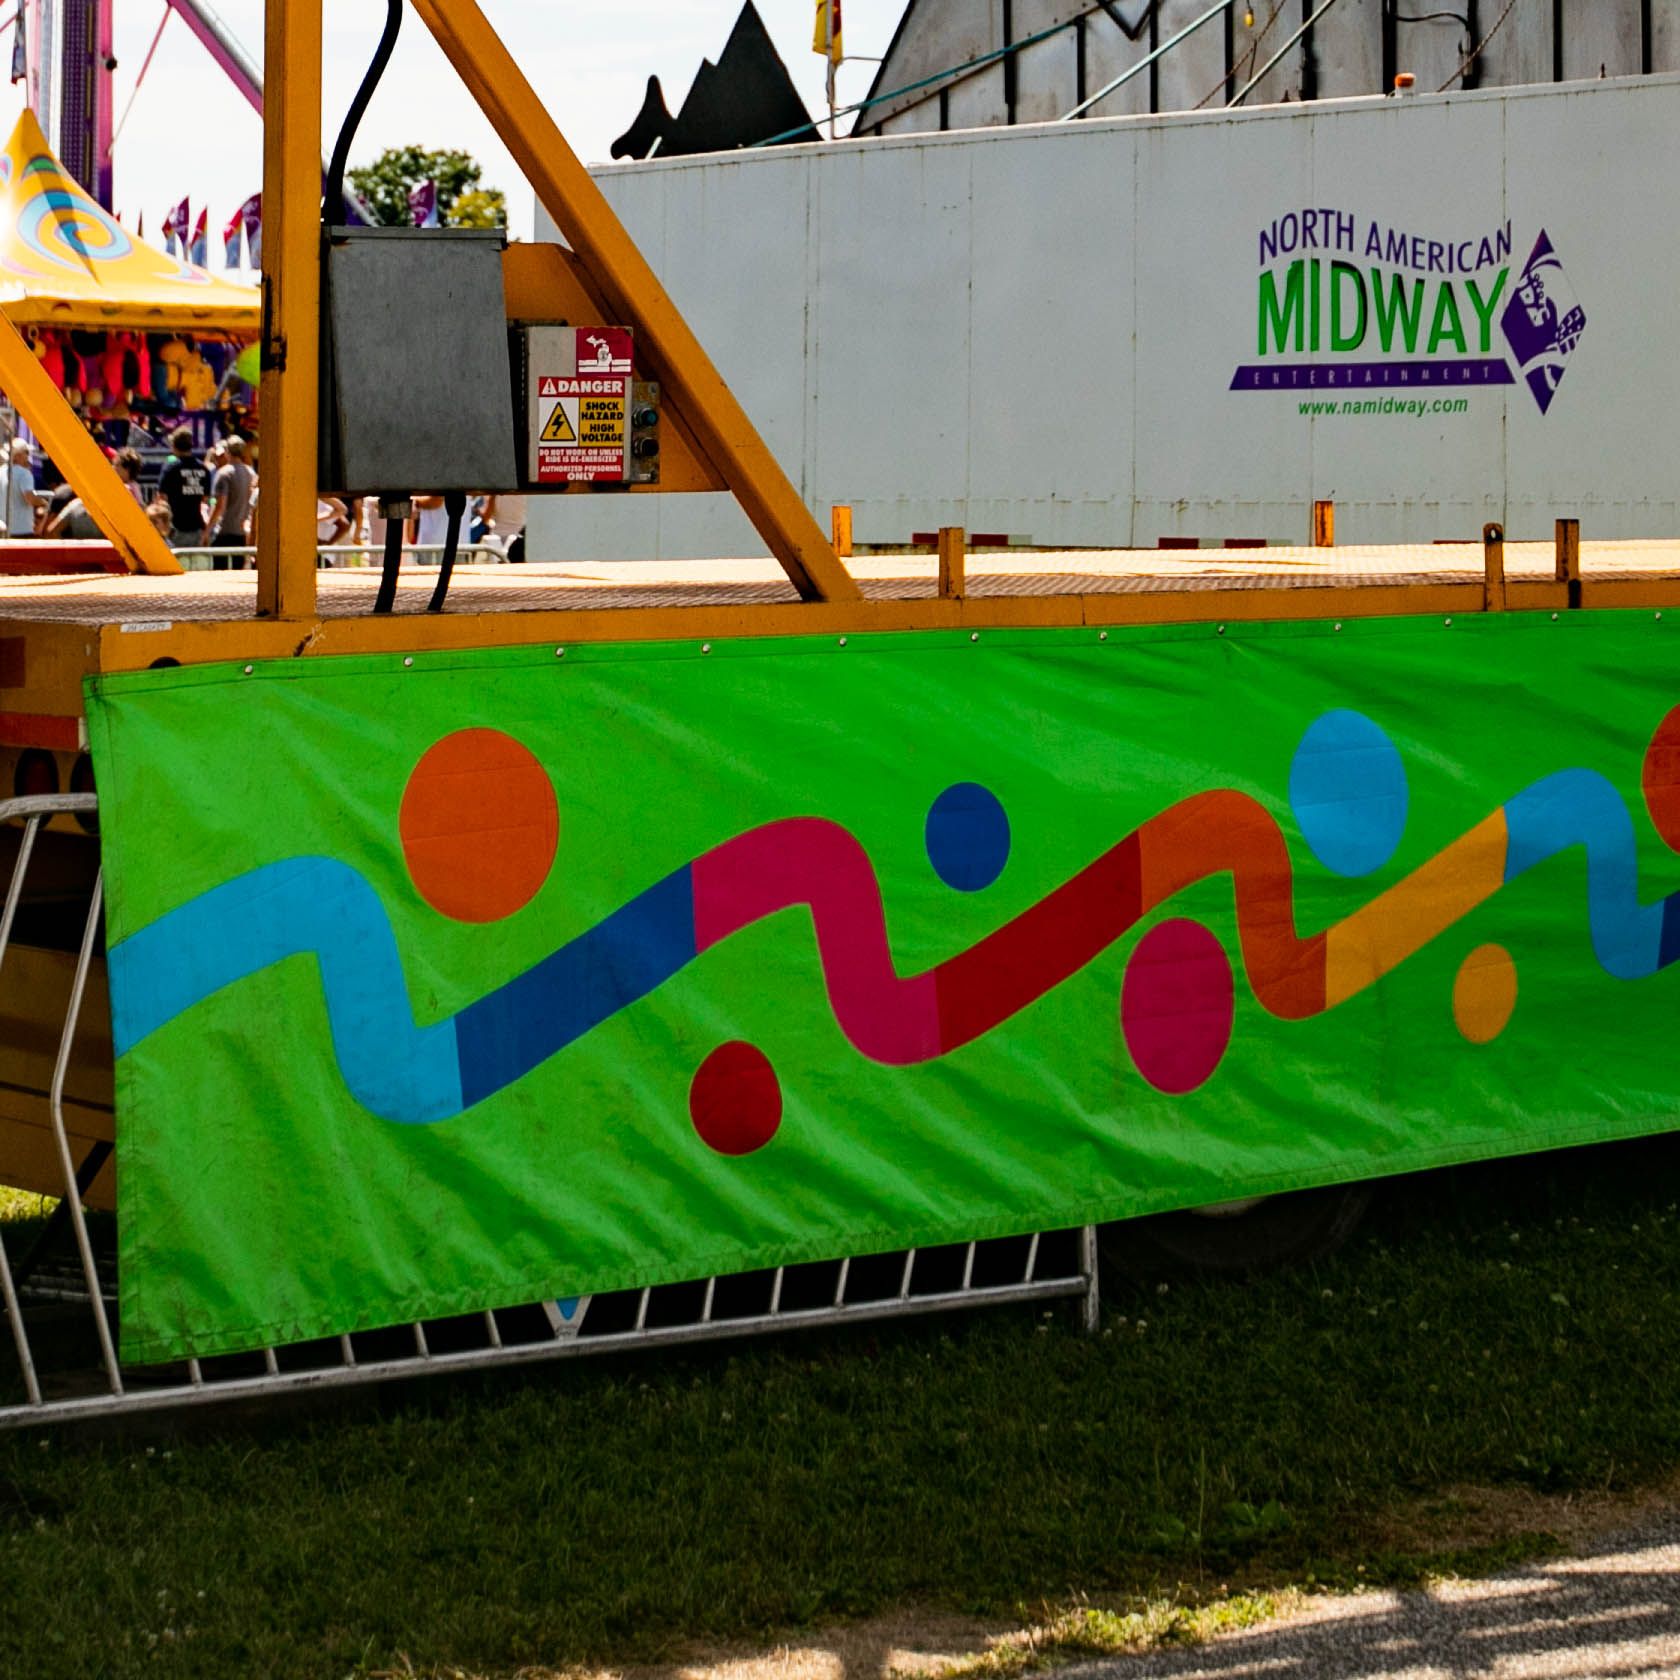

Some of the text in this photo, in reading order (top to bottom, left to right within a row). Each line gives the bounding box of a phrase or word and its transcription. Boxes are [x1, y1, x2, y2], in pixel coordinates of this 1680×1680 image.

[1259, 207, 1512, 274] NORTH AMERICAN
[1258, 258, 1510, 356] MIDWAY
[1254, 366, 1490, 385] ENTERTAINMENT
[558, 380, 623, 393] DANGER
[585, 401, 619, 410] SHOCK
[1298, 396, 1468, 417] www.namidway.com
[581, 411, 624, 420] HAZARD
[589, 423, 615, 432] HIGH
[581, 433, 623, 442] VOLTAGE
[588, 448, 598, 456] ON
[599, 448, 623, 456] UNLESS
[566, 472, 595, 480] ONLY
